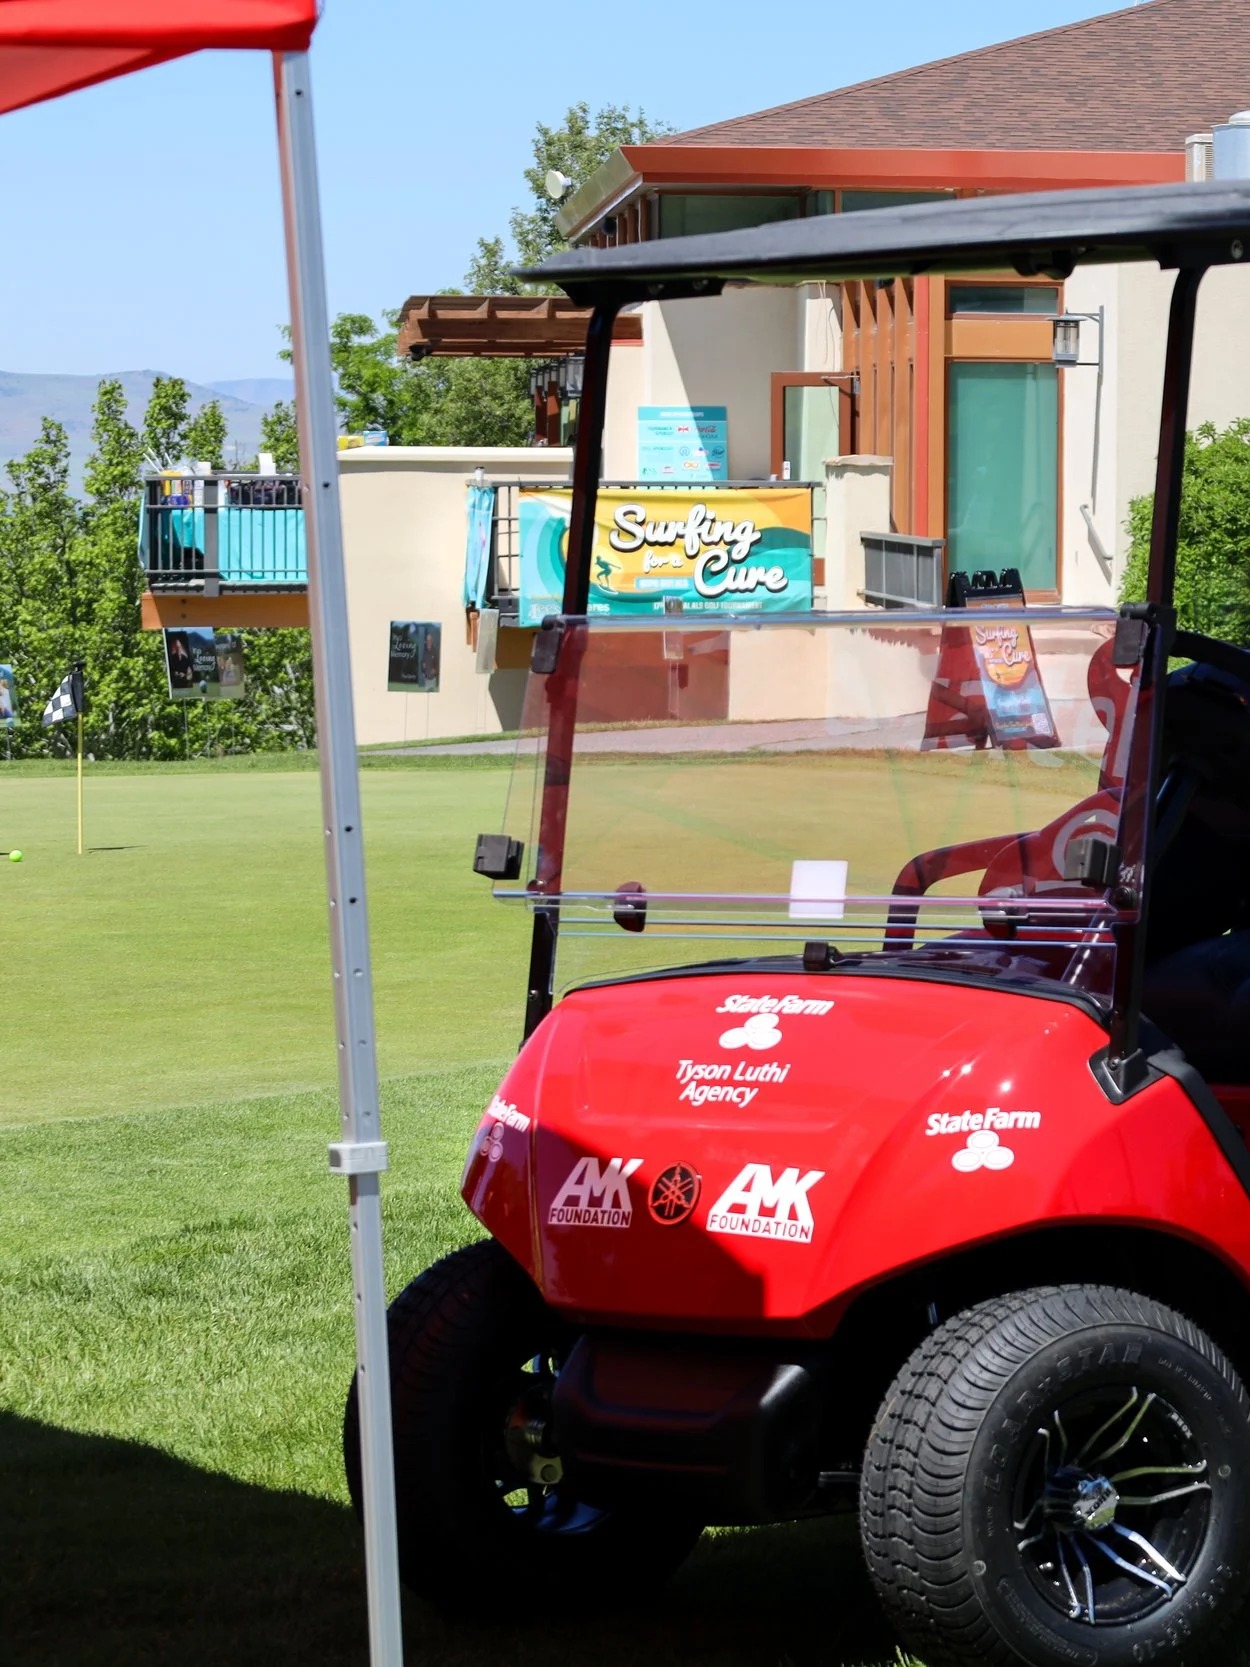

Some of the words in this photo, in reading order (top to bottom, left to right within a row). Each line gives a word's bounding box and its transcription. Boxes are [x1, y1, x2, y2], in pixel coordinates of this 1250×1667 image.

[609, 502, 761, 561] Surfing
[643, 550, 666, 573] for
[671, 559, 684, 569] a
[693, 548, 788, 599] Cure
[976, 625, 1018, 648] Surfing
[1002, 643, 1031, 666] Cure
[675, 1059, 732, 1085] Tyson
[733, 1061, 791, 1083] Luthi
[679, 1081, 759, 1108] Agency
[550, 1156, 645, 1210] AMK
[711, 1163, 826, 1223] AMK
[549, 1209, 632, 1227] FOUNDATION
[708, 1214, 811, 1241] FOUNDATION
